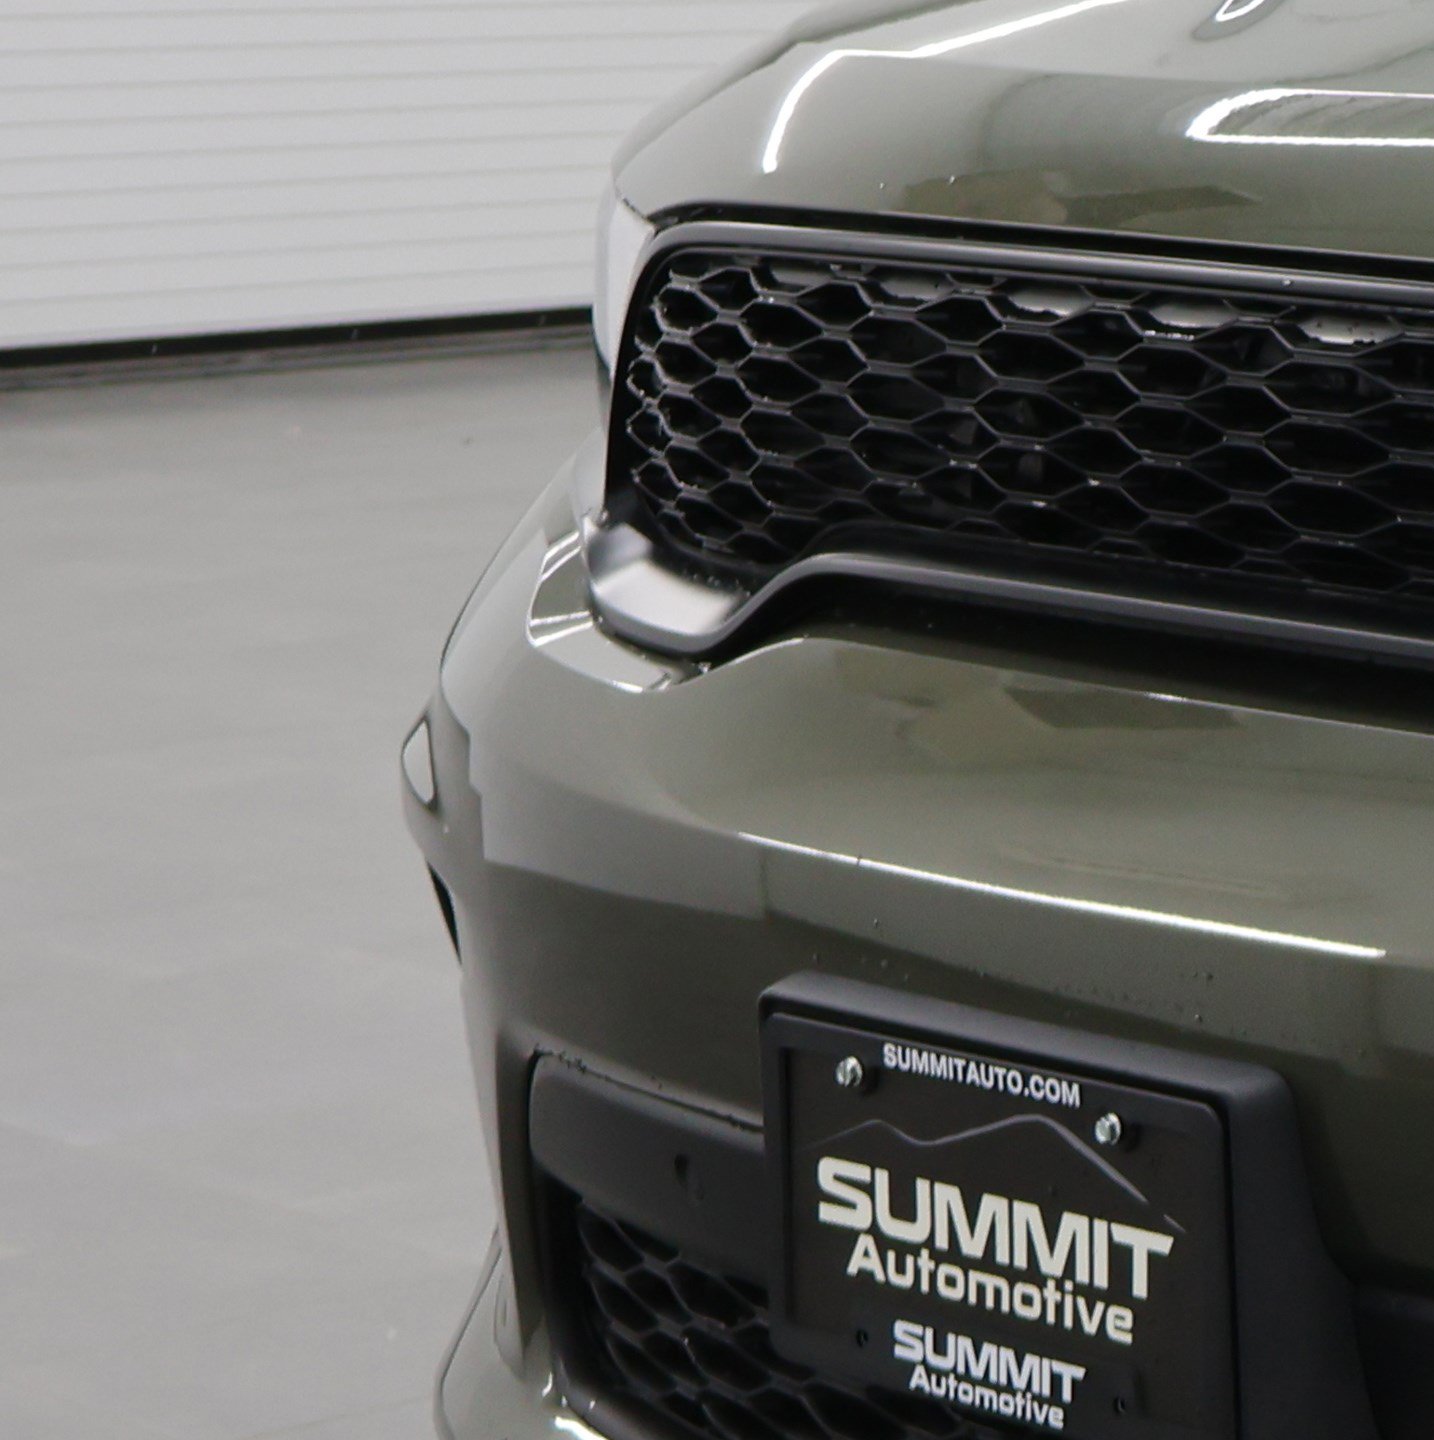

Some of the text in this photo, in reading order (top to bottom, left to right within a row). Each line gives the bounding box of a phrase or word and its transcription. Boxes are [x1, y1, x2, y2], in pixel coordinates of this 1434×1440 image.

[882, 1042, 1081, 1109] SUMMITAUTO.COM
[817, 1155, 1174, 1300] SUMMIT
[846, 1232, 1135, 1345] Automotive
[893, 1318, 1087, 1404] SUMMIT
[909, 1363, 1065, 1430] Automotive
